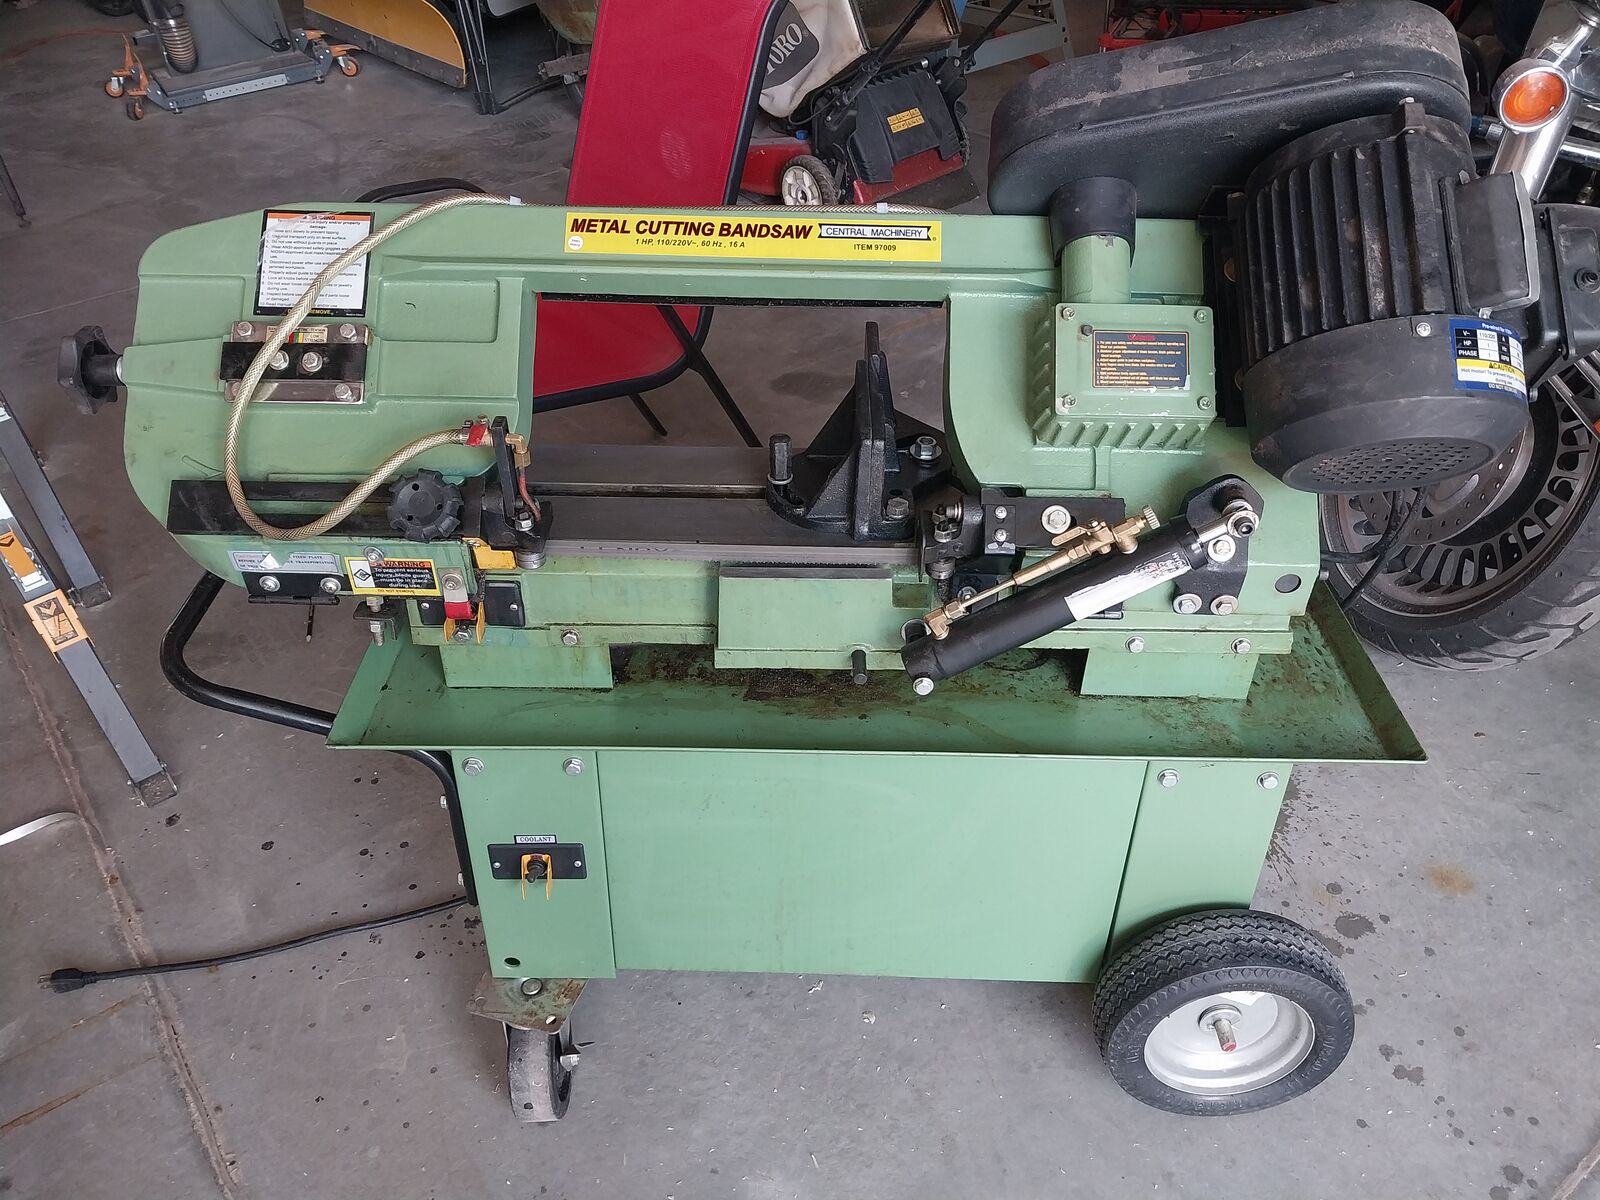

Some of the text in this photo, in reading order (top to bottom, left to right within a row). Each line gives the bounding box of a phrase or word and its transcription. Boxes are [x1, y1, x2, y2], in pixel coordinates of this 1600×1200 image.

[570, 218, 923, 240] METAL CUTTING BANDSAW CENTRAL MACHINERY
[1493, 362, 1516, 374] CAUTION
